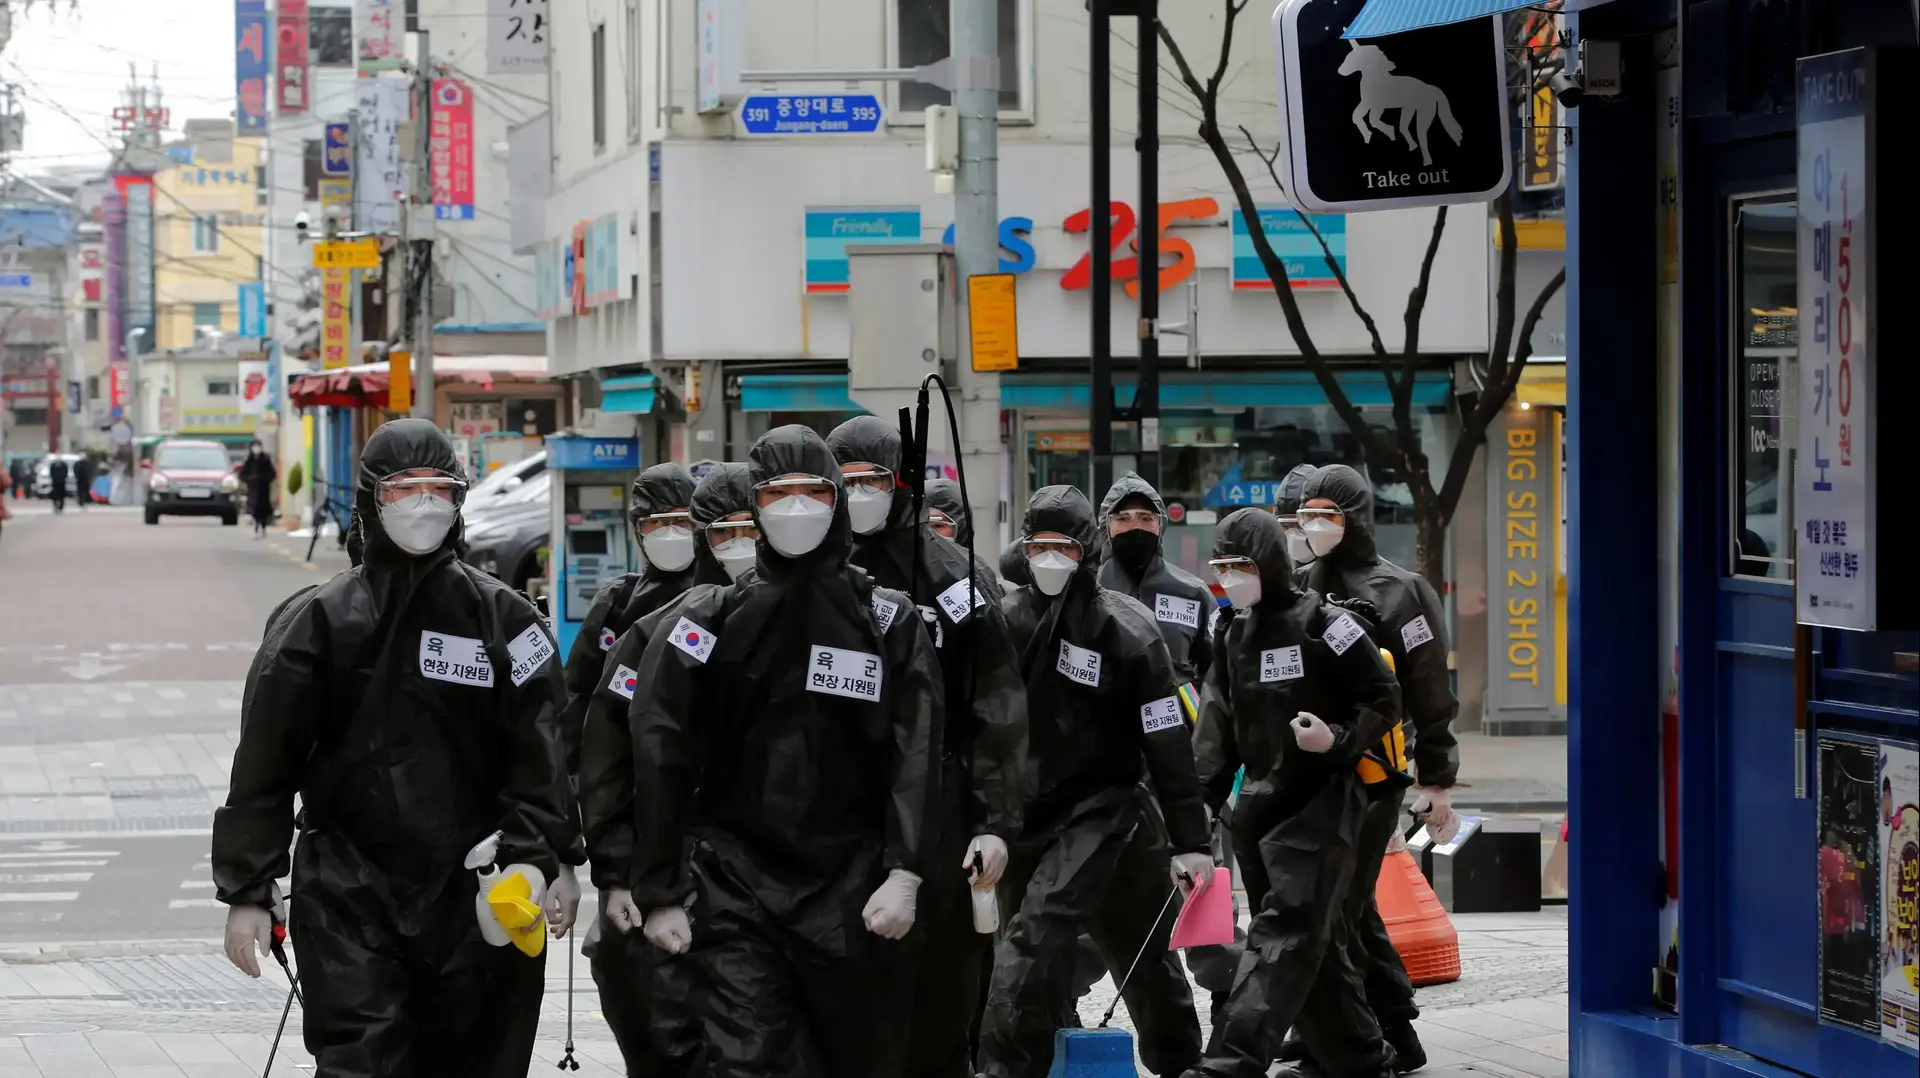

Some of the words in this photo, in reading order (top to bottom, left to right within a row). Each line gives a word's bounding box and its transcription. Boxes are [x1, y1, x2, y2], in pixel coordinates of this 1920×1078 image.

[1804, 73, 1834, 108] TAKE
[747, 108, 769, 121] 391
[776, 98, 846, 117] 중앙대로
[852, 106, 876, 120] 395
[1363, 171, 1411, 189] Take
[1418, 168, 1450, 184] out
[832, 217, 893, 237] Friendly
[942, 216, 1036, 274] S
[1060, 196, 1219, 301] 25
[1812, 147, 1834, 491] 아메리카노
[1838, 172, 1853, 466] 1,500원
[593, 445, 628, 457] ATM
[1507, 429, 1536, 481] BIG
[1507, 492, 1537, 560] SIZE
[1820, 551, 1842, 577] 신선한
[1843, 552, 1858, 579] 원두
[1507, 575, 1537, 588] 2
[943, 595, 955, 607] 육
[1160, 597, 1169, 608] 육
[1186, 602, 1195, 614] 군
[951, 604, 967, 619] 현장
[1158, 609, 1174, 619] 현장
[1175, 613, 1195, 625] 지원팀
[1326, 633, 1337, 643] 육
[1342, 618, 1353, 629] 군
[1415, 619, 1424, 631] 군
[427, 637, 443, 656] 육
[527, 631, 543, 648] 군
[1334, 639, 1349, 652] 현장
[1344, 628, 1361, 641] 지원팀
[1412, 631, 1430, 644] 지원팀
[1508, 602, 1538, 686] SHOT
[512, 663, 530, 680] 현장
[529, 644, 550, 666] 지원팀
[816, 651, 834, 670] 육
[864, 659, 877, 678] 군
[1063, 644, 1070, 659] 육
[1087, 654, 1097, 669] 군
[1265, 653, 1275, 666] 육
[1290, 649, 1299, 662] 군
[423, 658, 449, 675] 현장
[452, 664, 490, 682] 지원팀
[1264, 668, 1280, 679] 현장
[1281, 664, 1301, 676] 지원팀
[812, 672, 839, 690] 현장
[841, 677, 876, 696] 지원팀
[1144, 706, 1153, 717] 육
[1166, 700, 1175, 712] 군
[1145, 719, 1159, 729] 현장
[1160, 714, 1180, 725] 지원팀
